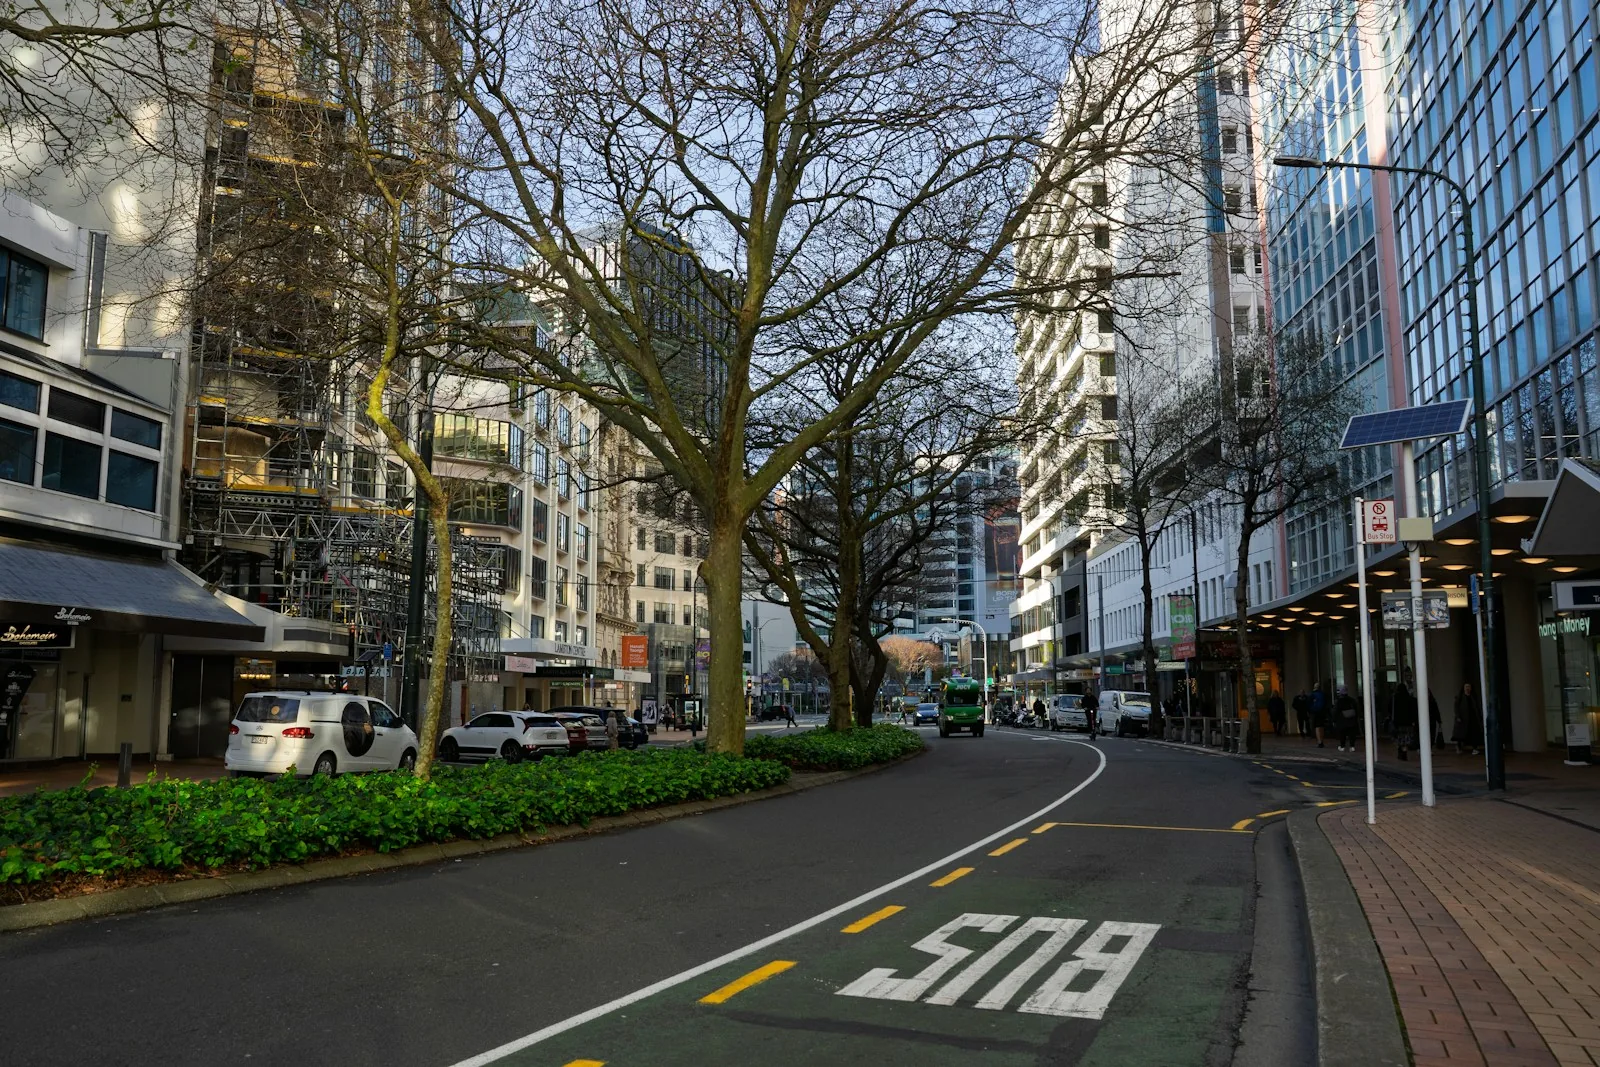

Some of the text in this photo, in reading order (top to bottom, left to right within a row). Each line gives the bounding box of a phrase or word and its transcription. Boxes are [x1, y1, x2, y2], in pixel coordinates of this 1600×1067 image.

[1379, 532, 1394, 540] Stop
[1563, 616, 1591, 636] Money
[834, 912, 1162, 1020] BUS
